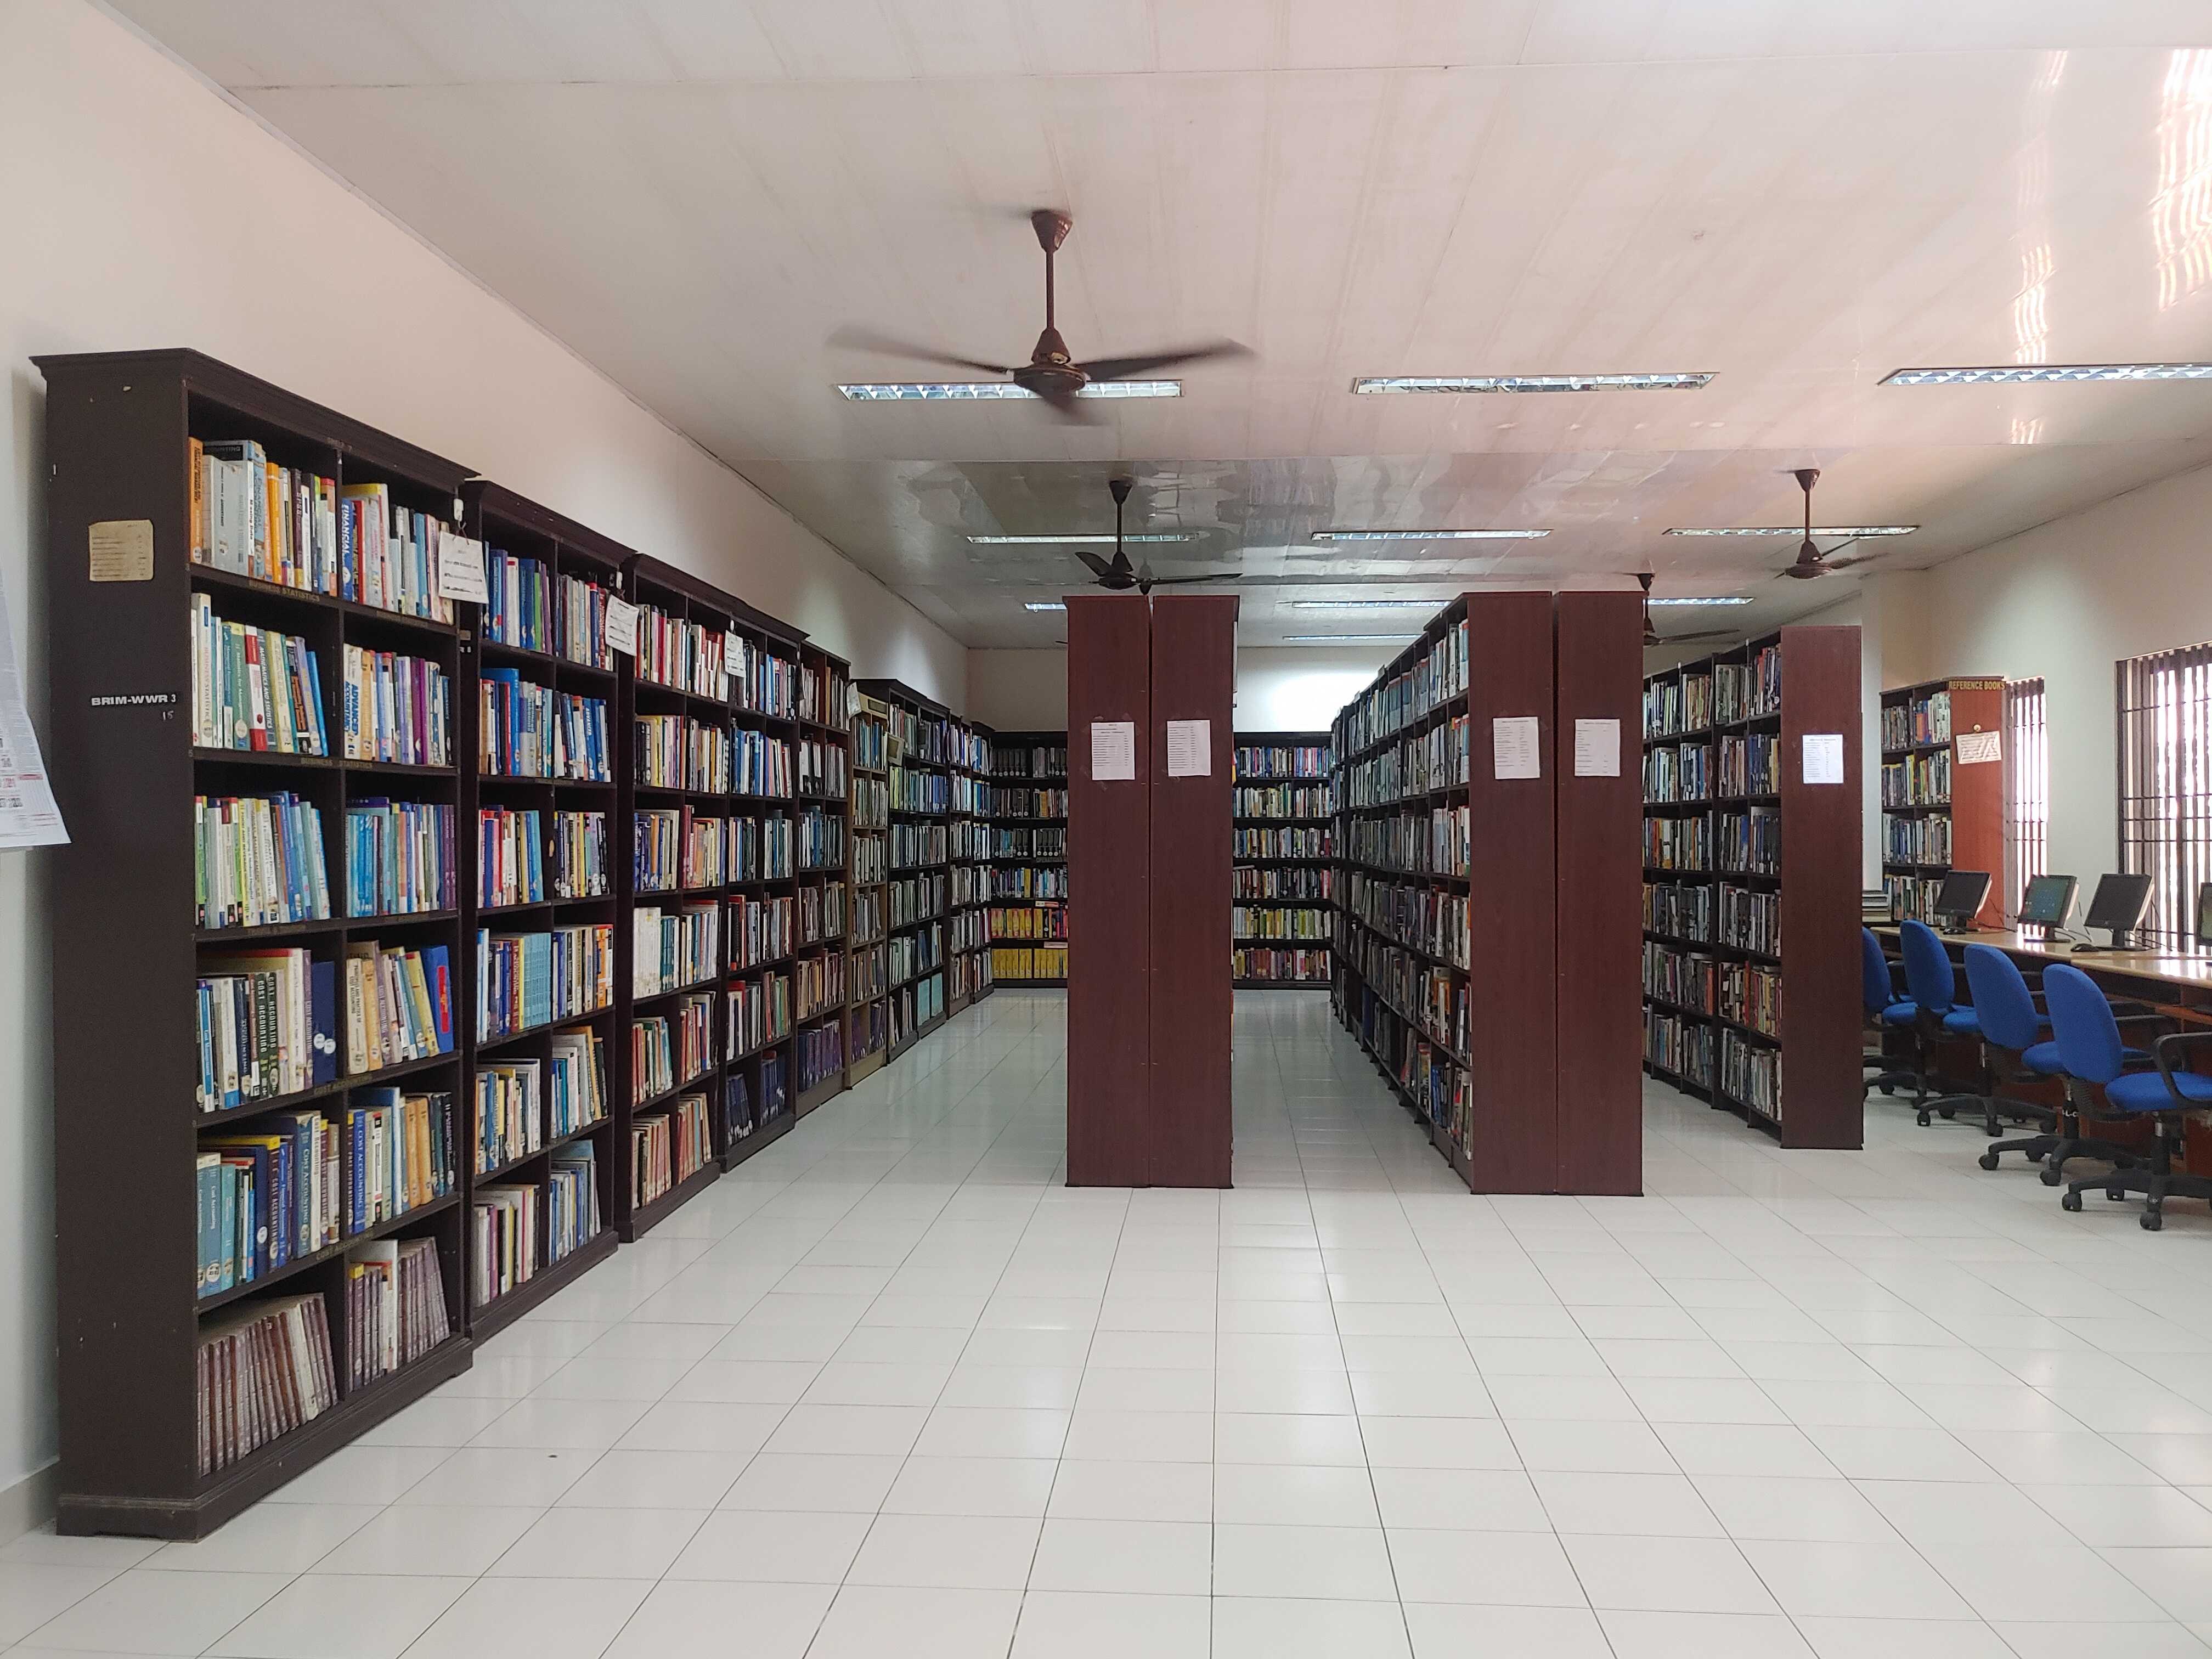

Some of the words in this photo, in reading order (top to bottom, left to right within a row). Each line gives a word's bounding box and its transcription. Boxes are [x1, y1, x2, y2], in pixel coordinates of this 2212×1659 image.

[1948, 680, 1983, 690] REFERENCE
[1984, 680, 2006, 690] BOOKS
[91, 695, 168, 706] BRIM-WWR
[171, 693, 176, 703] 3
[269, 1001, 277, 1049] ACCOUNTING
